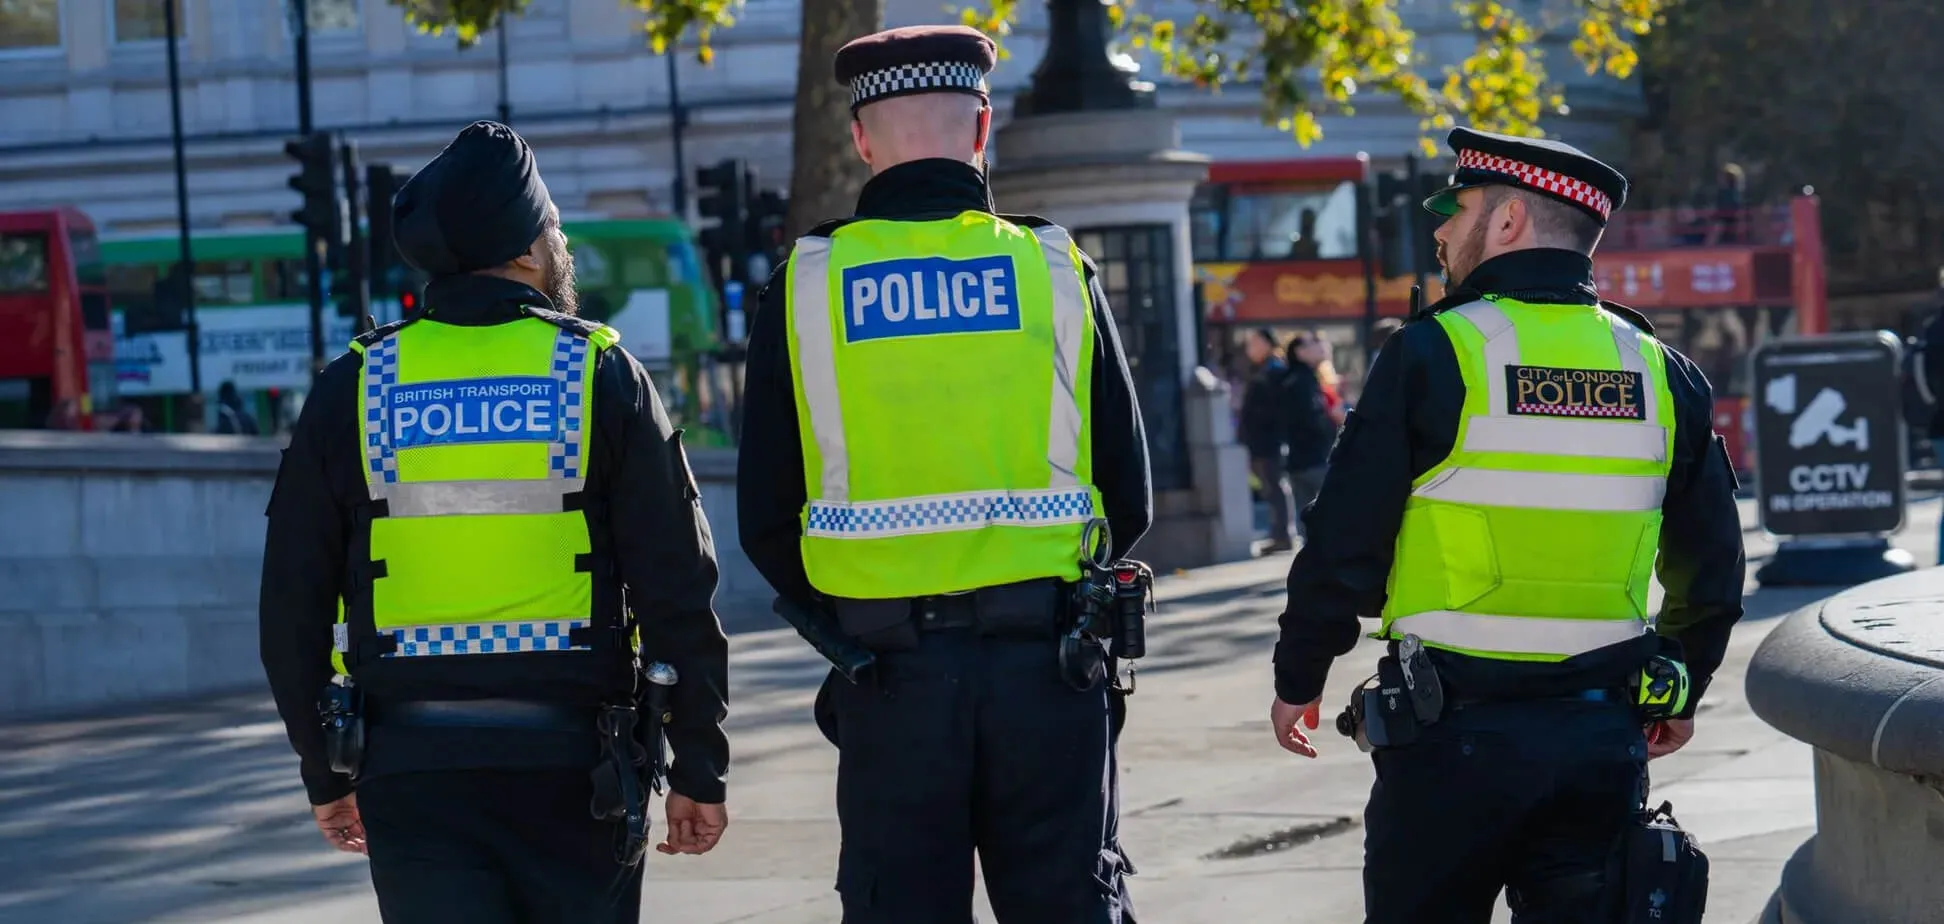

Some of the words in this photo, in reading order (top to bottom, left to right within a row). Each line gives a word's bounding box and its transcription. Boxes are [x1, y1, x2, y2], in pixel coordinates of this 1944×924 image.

[852, 268, 1009, 326] POLICE
[1517, 368, 1552, 379] CITY
[1564, 370, 1636, 384] LONDON
[394, 387, 453, 404] BRITISH
[458, 383, 552, 398] TRANSPORT
[1517, 379, 1636, 408] POLICE
[394, 400, 552, 439] POLICE
[1788, 463, 1869, 492] CCTV
[1769, 495, 1790, 512] IN
[1793, 491, 1893, 511] OPERATION
